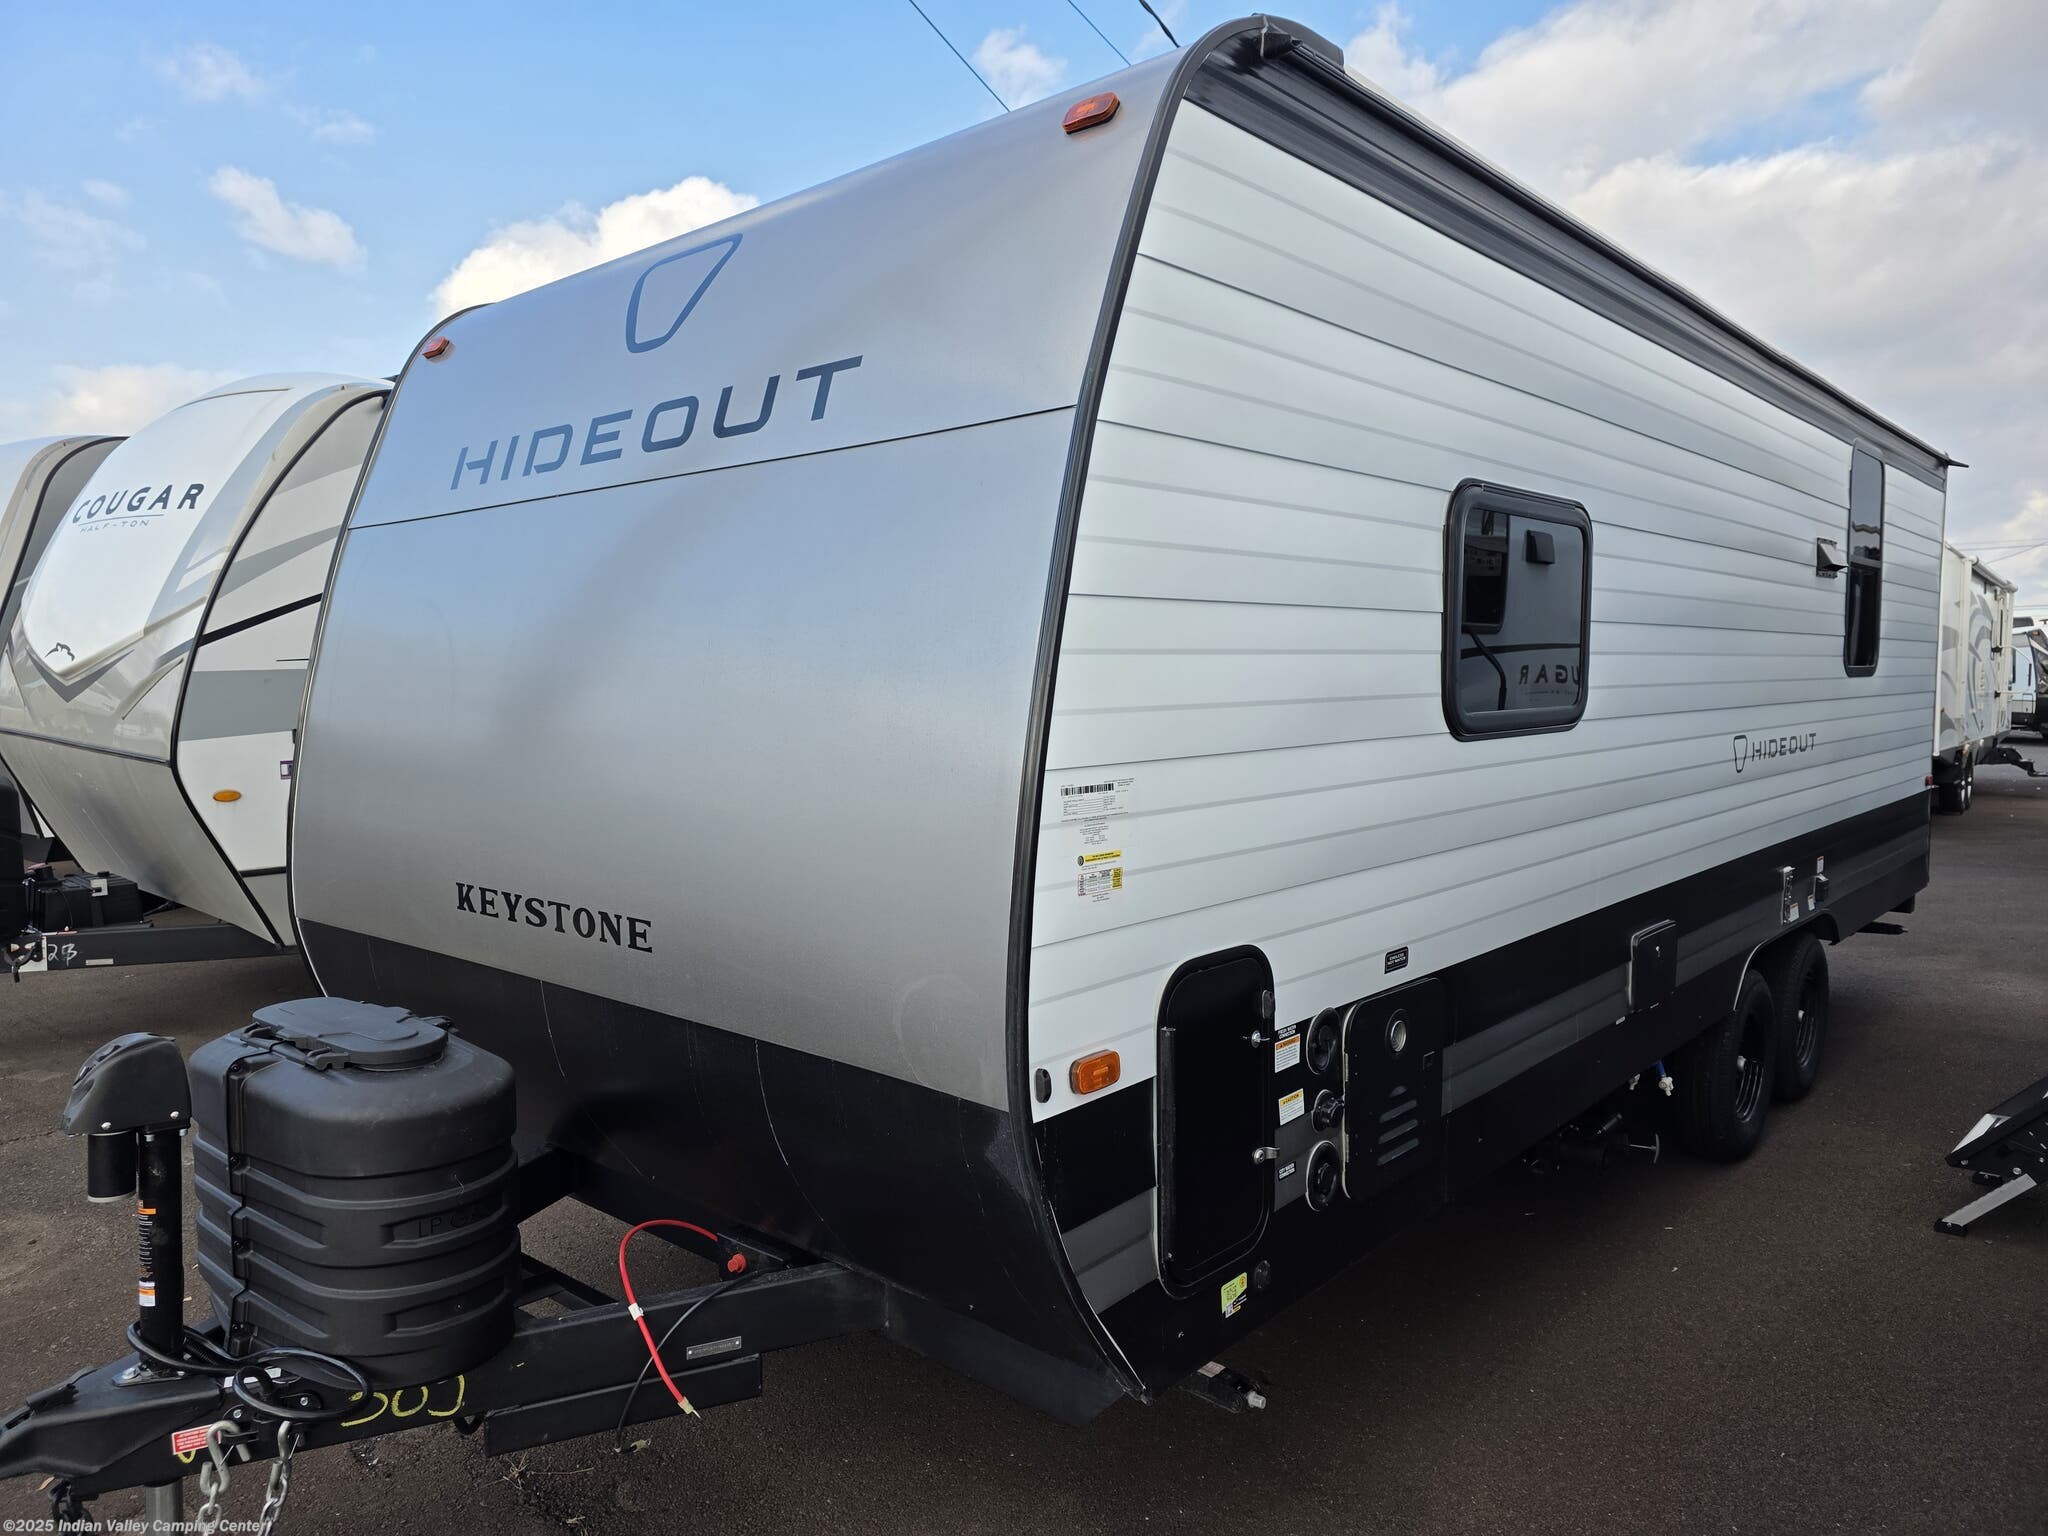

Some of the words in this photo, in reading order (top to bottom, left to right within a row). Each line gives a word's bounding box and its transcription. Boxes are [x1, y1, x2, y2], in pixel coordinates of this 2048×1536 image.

[450, 355, 863, 490] HIDEOUT
[72, 483, 205, 524] COUGAR
[80, 519, 150, 534] HALF-TON
[1751, 732, 1817, 762] HIDEOUT
[456, 882, 653, 953] KEYSTONE
